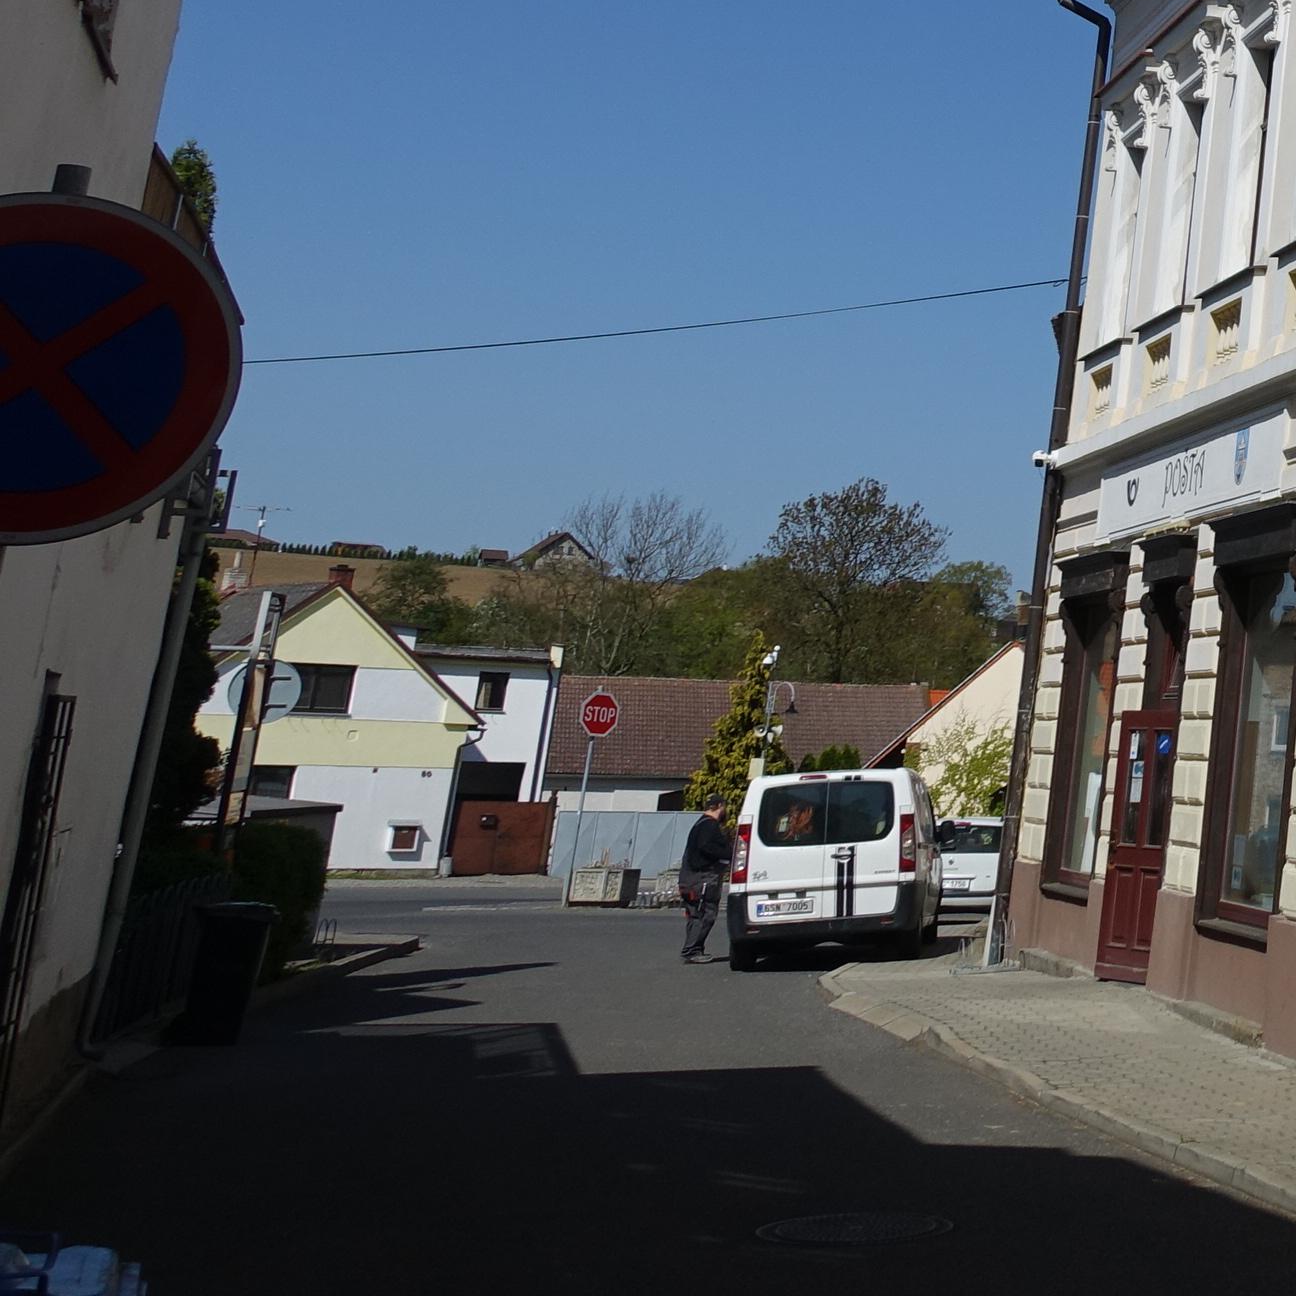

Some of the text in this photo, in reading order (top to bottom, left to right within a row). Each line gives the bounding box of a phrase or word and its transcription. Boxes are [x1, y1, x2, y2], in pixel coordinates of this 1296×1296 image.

[1161, 447, 1206, 508] POŠTA
[584, 705, 616, 723] STOP
[787, 901, 809, 911] 7005
